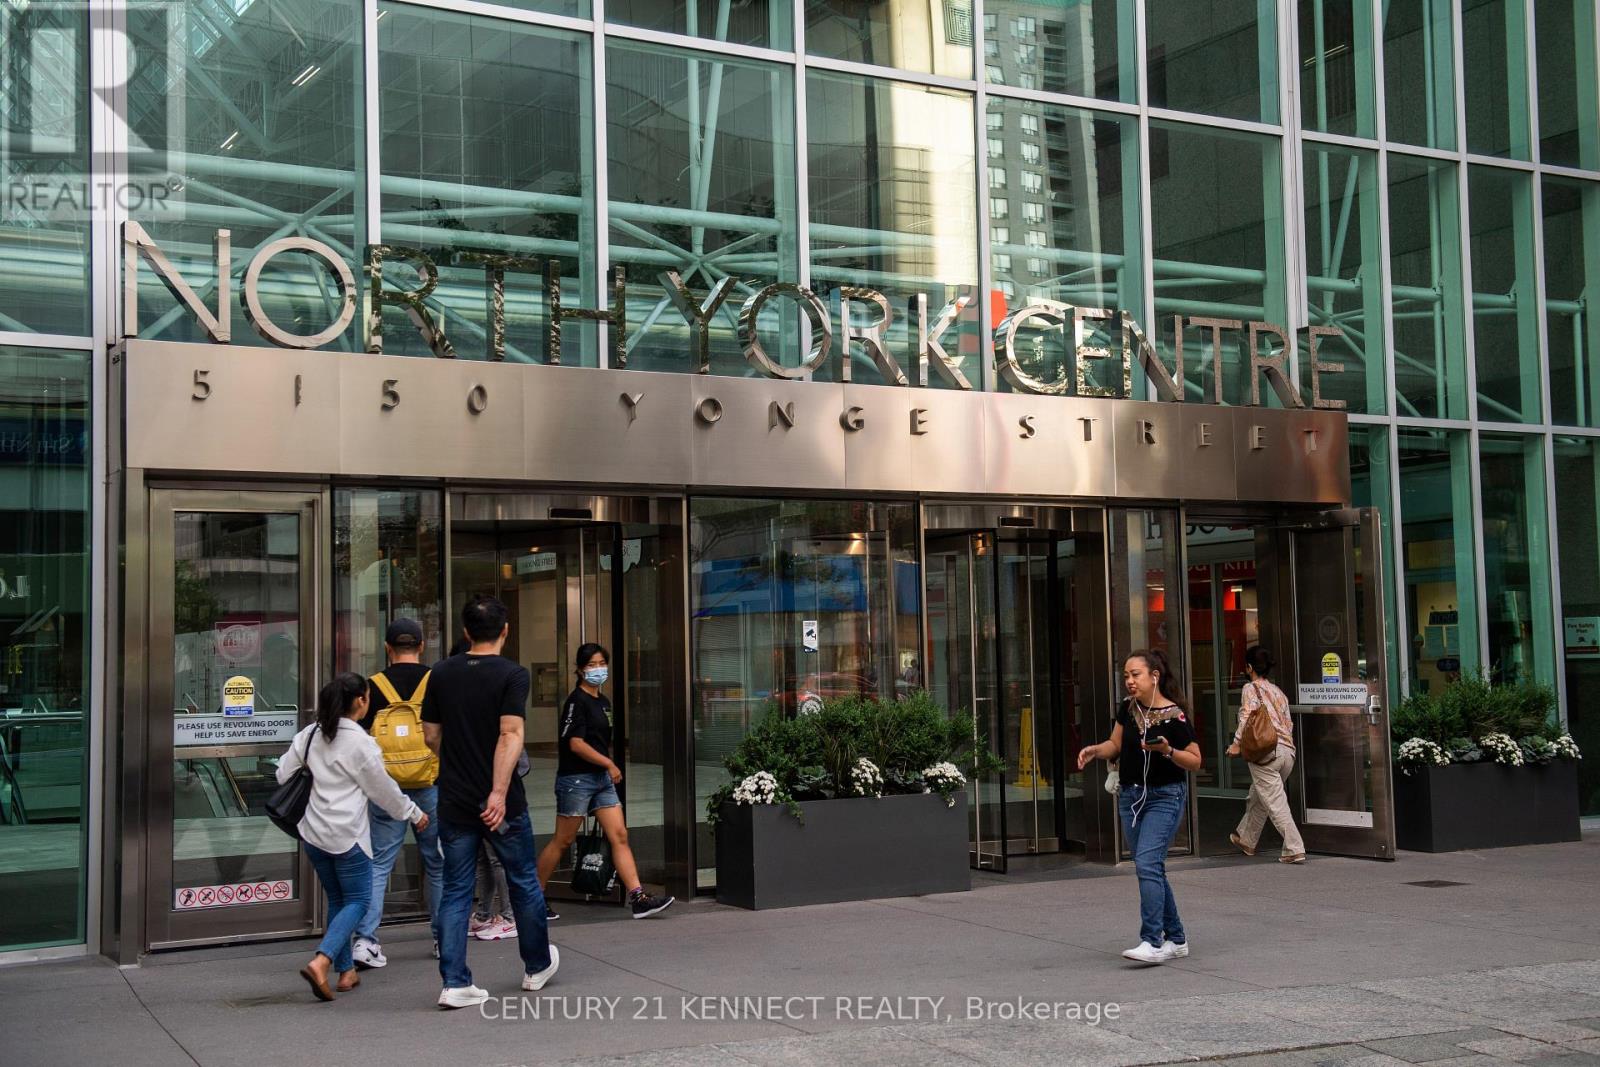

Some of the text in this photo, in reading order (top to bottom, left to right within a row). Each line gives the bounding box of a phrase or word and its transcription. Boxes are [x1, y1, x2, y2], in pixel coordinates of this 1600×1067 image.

[121, 220, 1347, 411] NORTH YORK CENTRE
[191, 369, 1320, 454] 5150 YONGE STREET
[177, 719, 294, 730] PLEASE USE REVOLVING DOORS
[194, 731, 213, 739] HELP
[227, 730, 247, 738] SAVE
[248, 729, 278, 737] ENERGY
